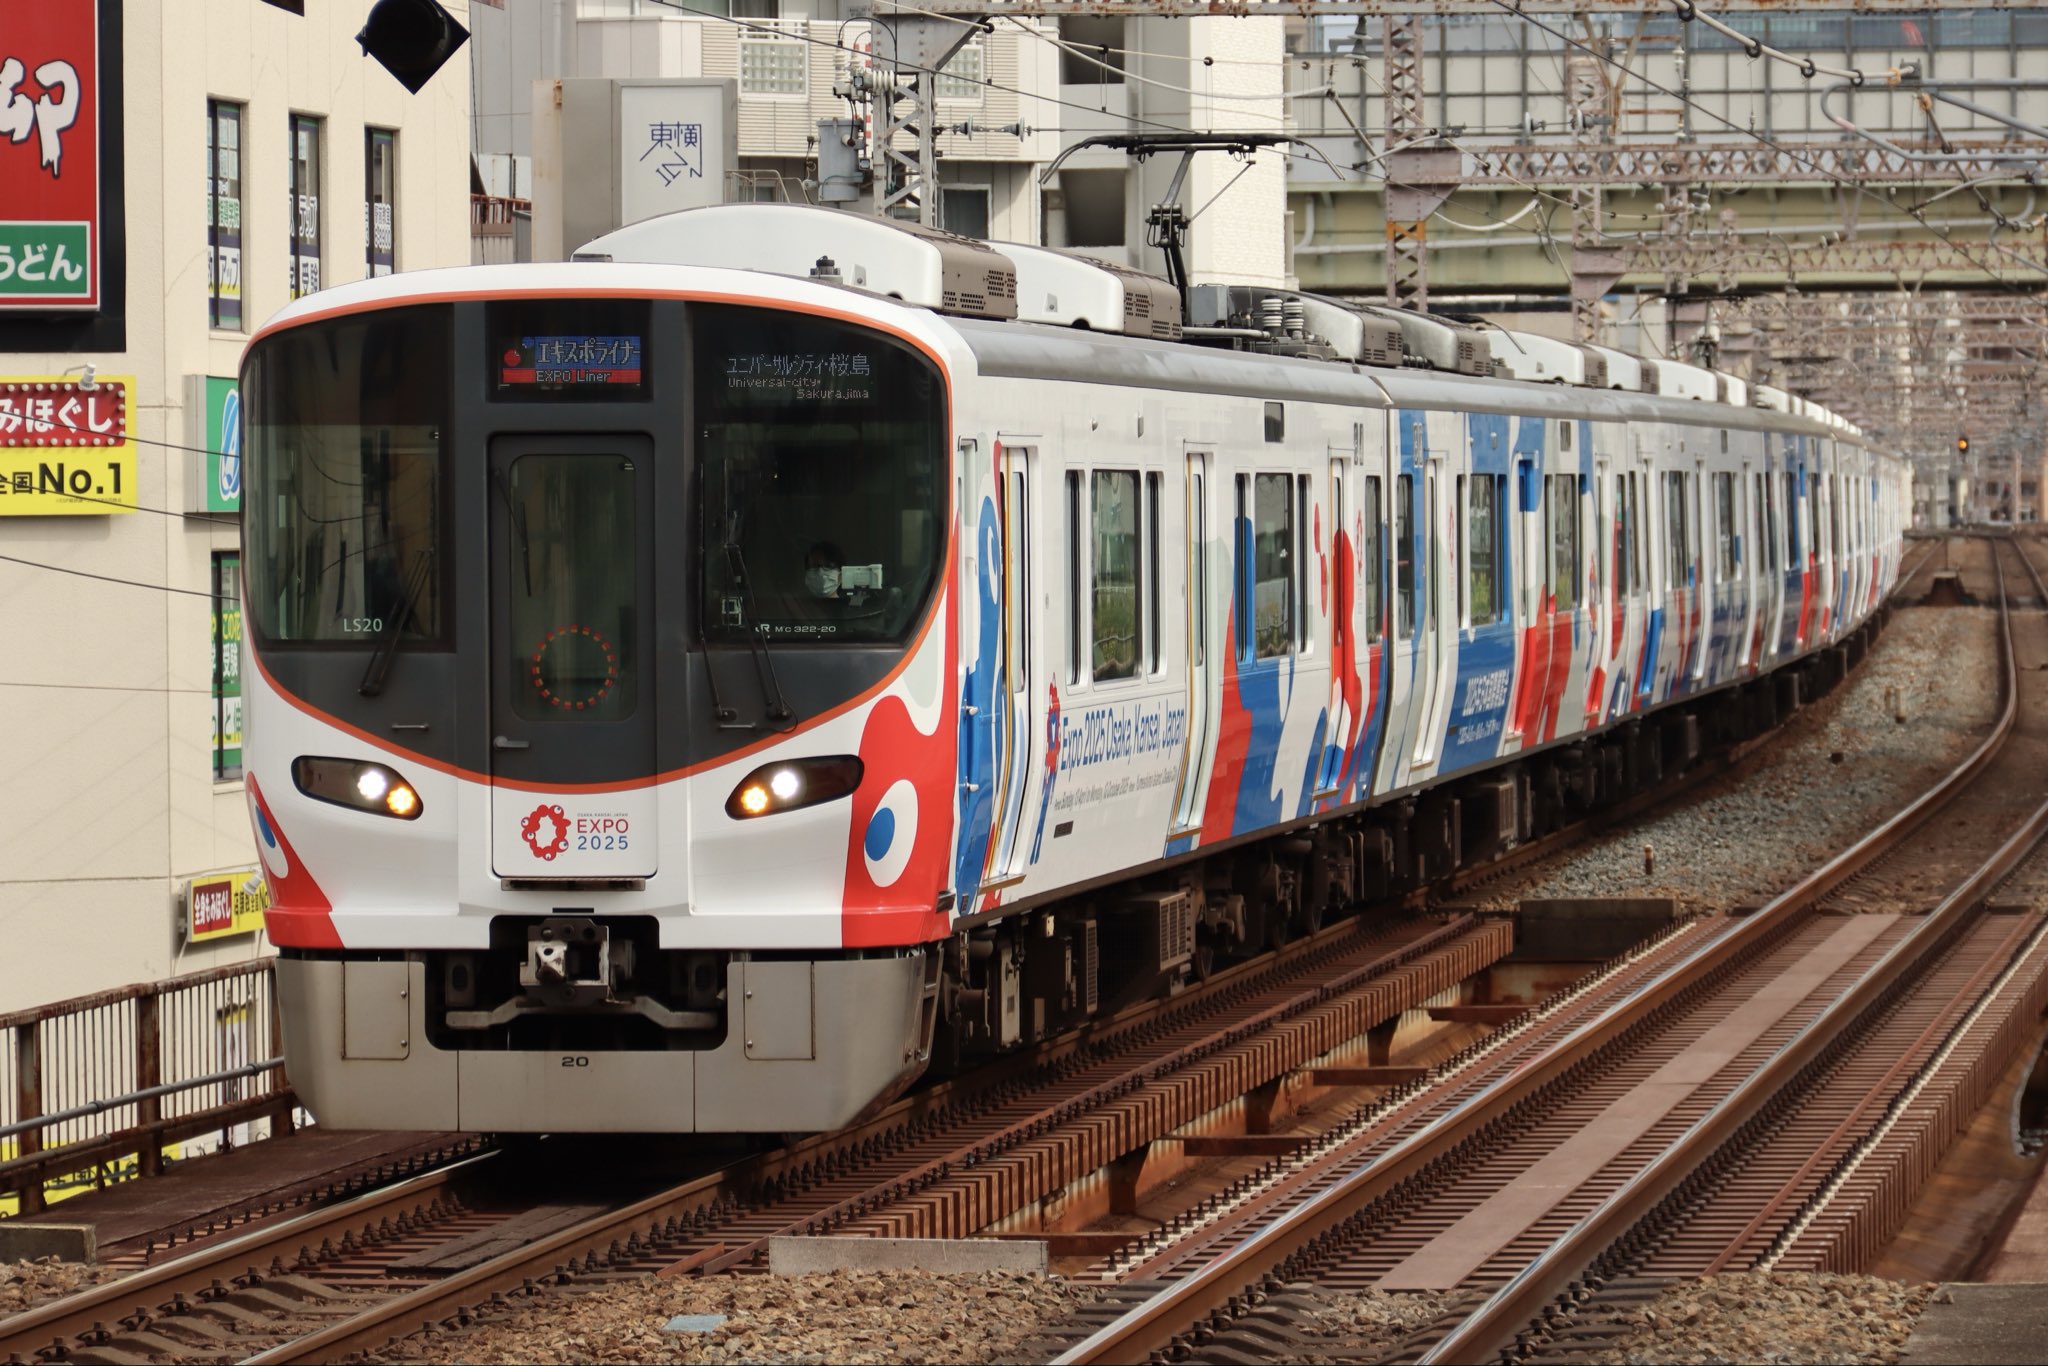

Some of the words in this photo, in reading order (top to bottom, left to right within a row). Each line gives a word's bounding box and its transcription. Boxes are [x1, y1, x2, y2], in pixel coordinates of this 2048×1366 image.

[537, 337, 641, 365] エキスポライナー
[536, 370, 571, 382] EXPO
[577, 370, 611, 382] Liner
[796, 388, 870, 400] Sakurajima
[343, 618, 383, 632] LS20
[1060, 716, 1083, 782] Expo
[1083, 709, 1106, 766] 2025
[1106, 705, 1133, 766] Osaka,
[1133, 701, 1161, 760] Kansai,
[1162, 698, 1185, 760] Japan
[577, 818, 629, 834] EXPO
[577, 835, 629, 851] 2025
[561, 1056, 589, 1067] 20
